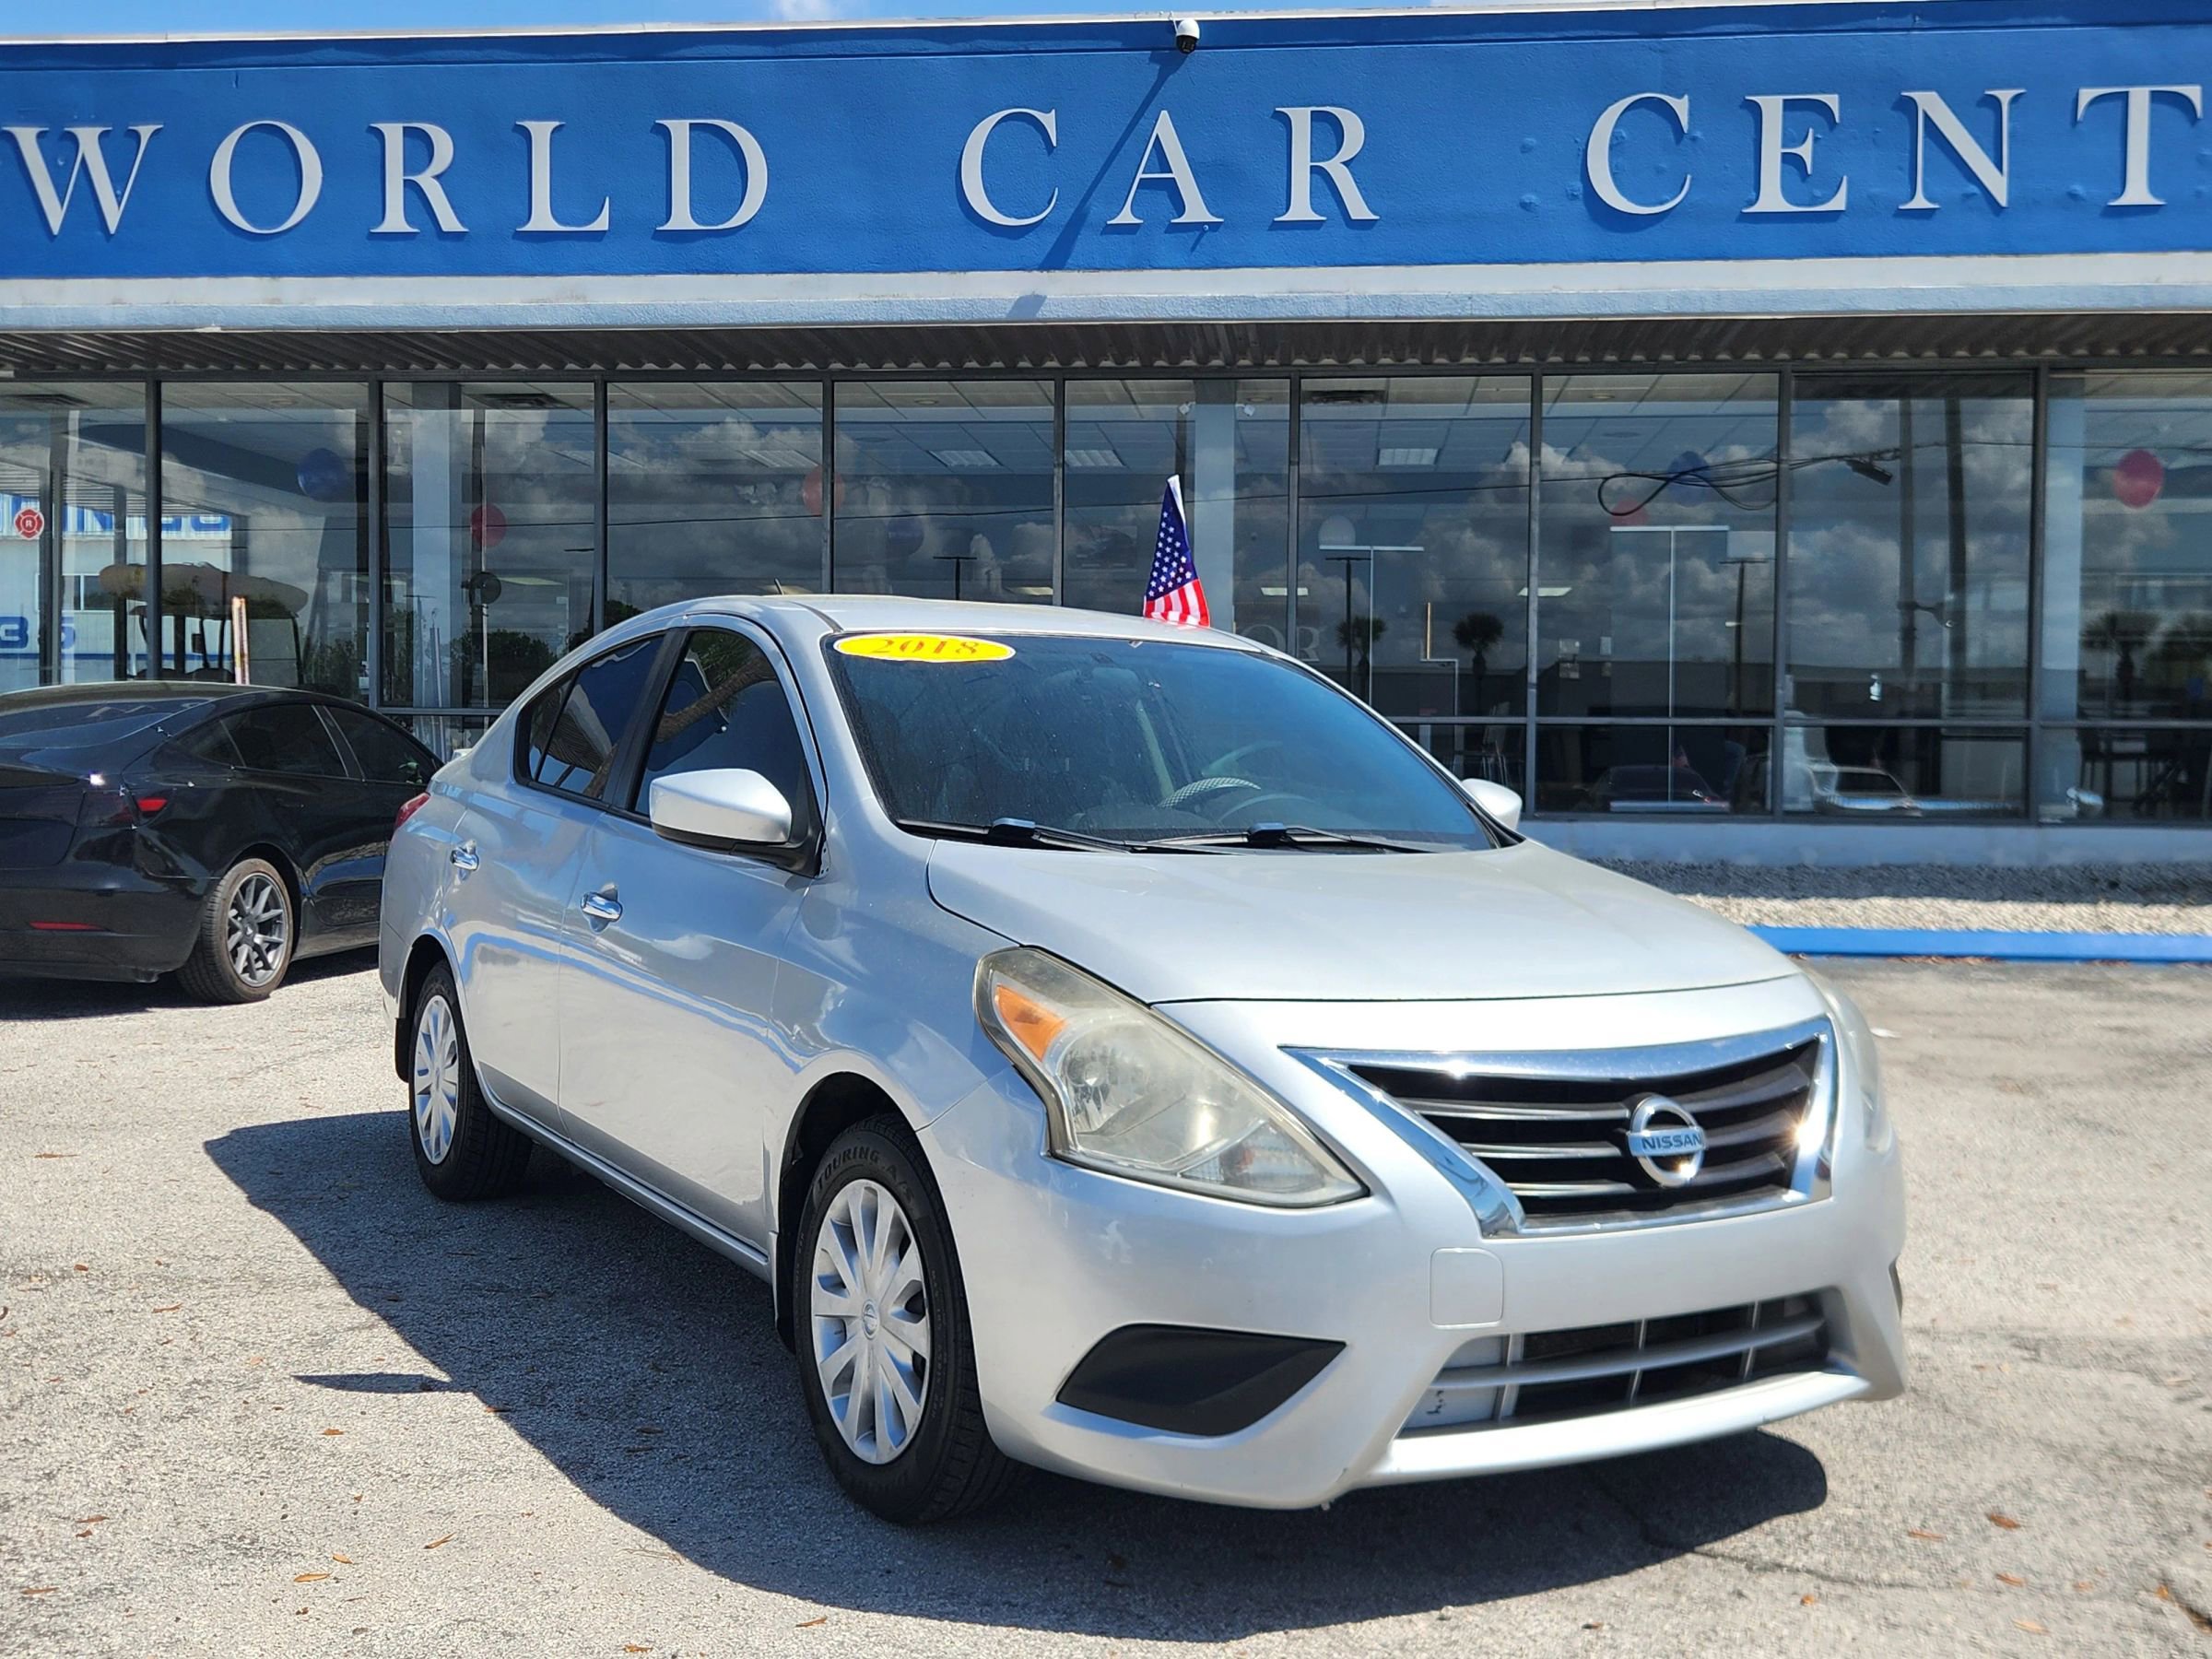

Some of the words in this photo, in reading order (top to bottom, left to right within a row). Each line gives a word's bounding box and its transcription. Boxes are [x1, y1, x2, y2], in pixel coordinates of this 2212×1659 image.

[2, 119, 769, 236] WORLD
[960, 105, 1381, 227] CAR
[1586, 84, 2204, 215] CENT
[872, 639, 980, 655] 2018
[1641, 1133, 1702, 1150] NISSAN
[818, 1146, 880, 1190] TOURING
